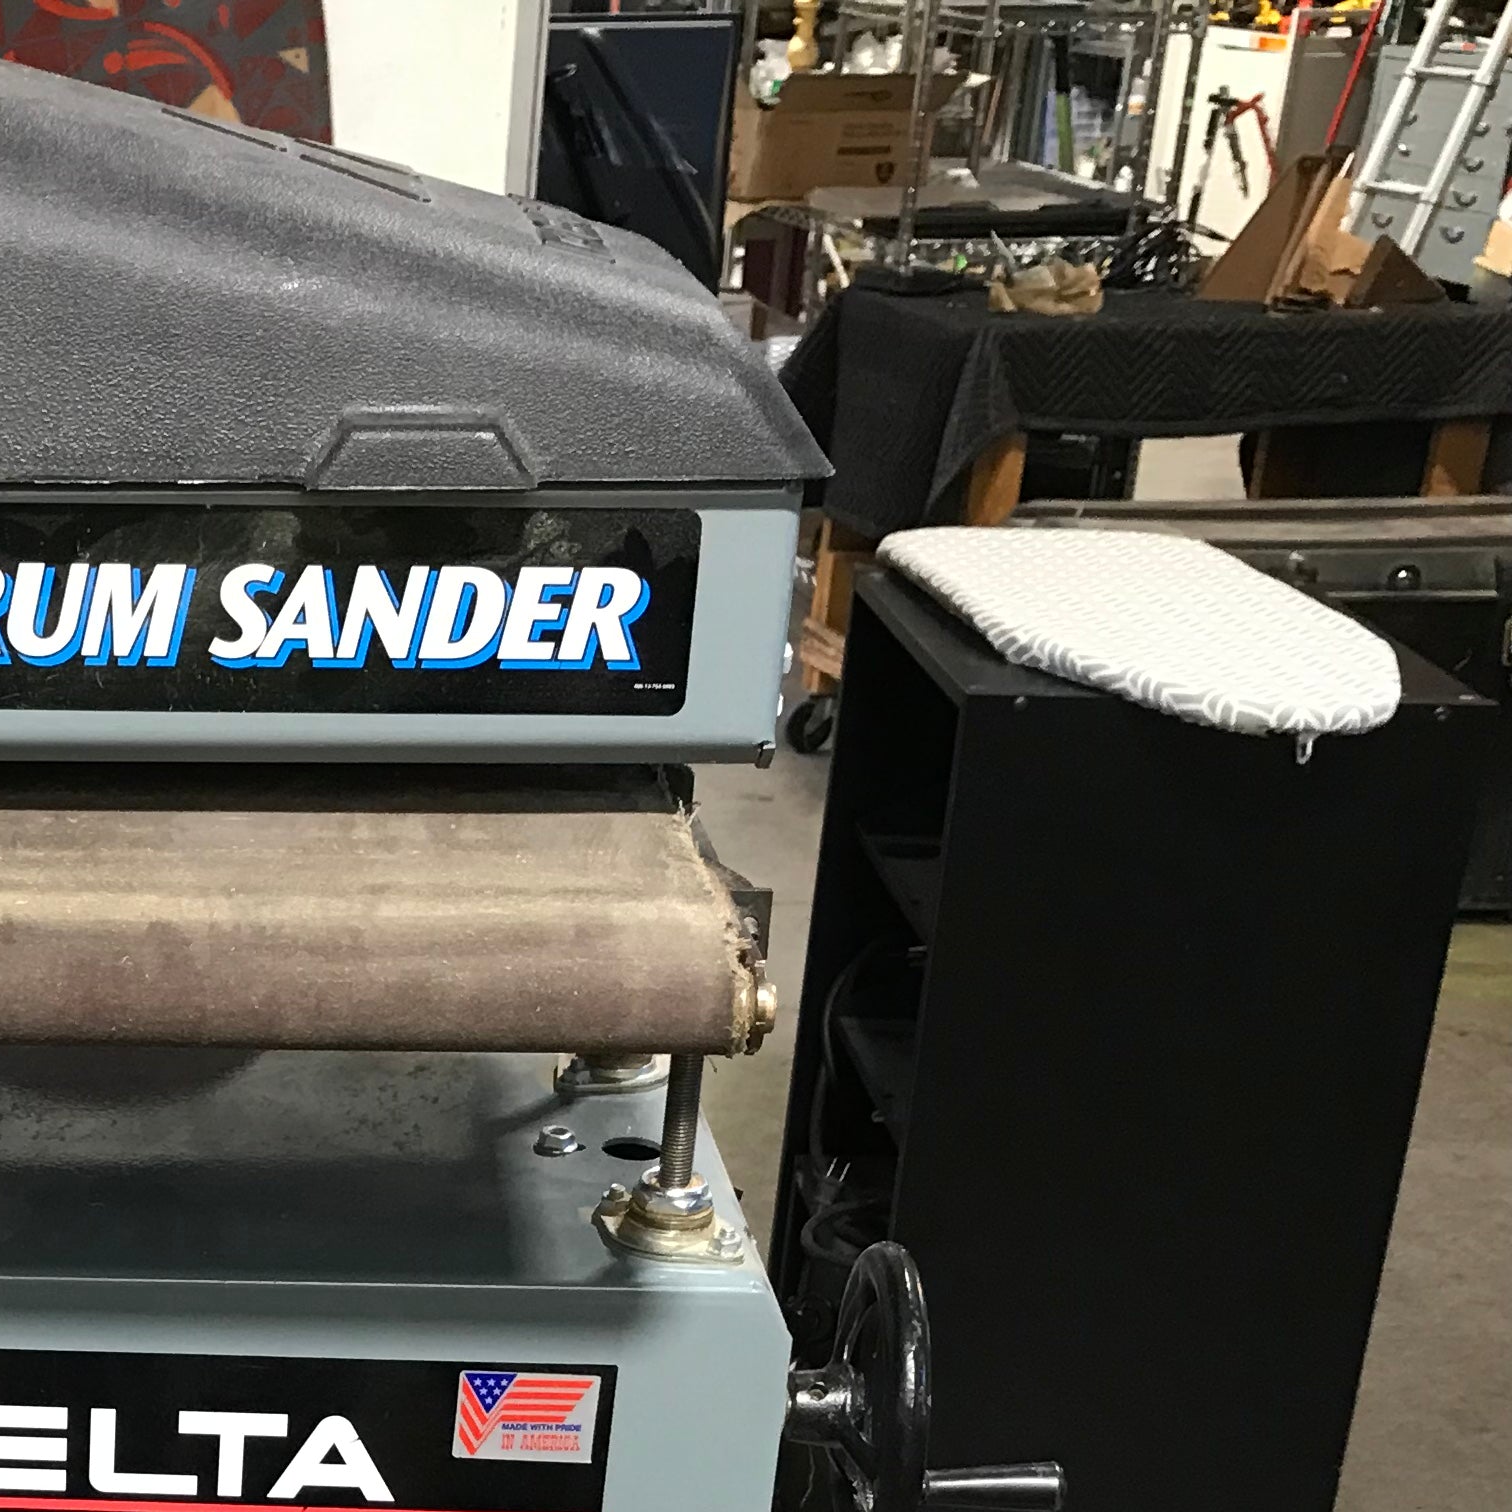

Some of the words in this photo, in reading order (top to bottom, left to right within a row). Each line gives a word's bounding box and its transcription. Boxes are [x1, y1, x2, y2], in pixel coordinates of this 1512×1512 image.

[209, 563, 650, 670] SANDER
[501, 1423, 528, 1431] MADE
[555, 1424, 582, 1432] PRIDE
